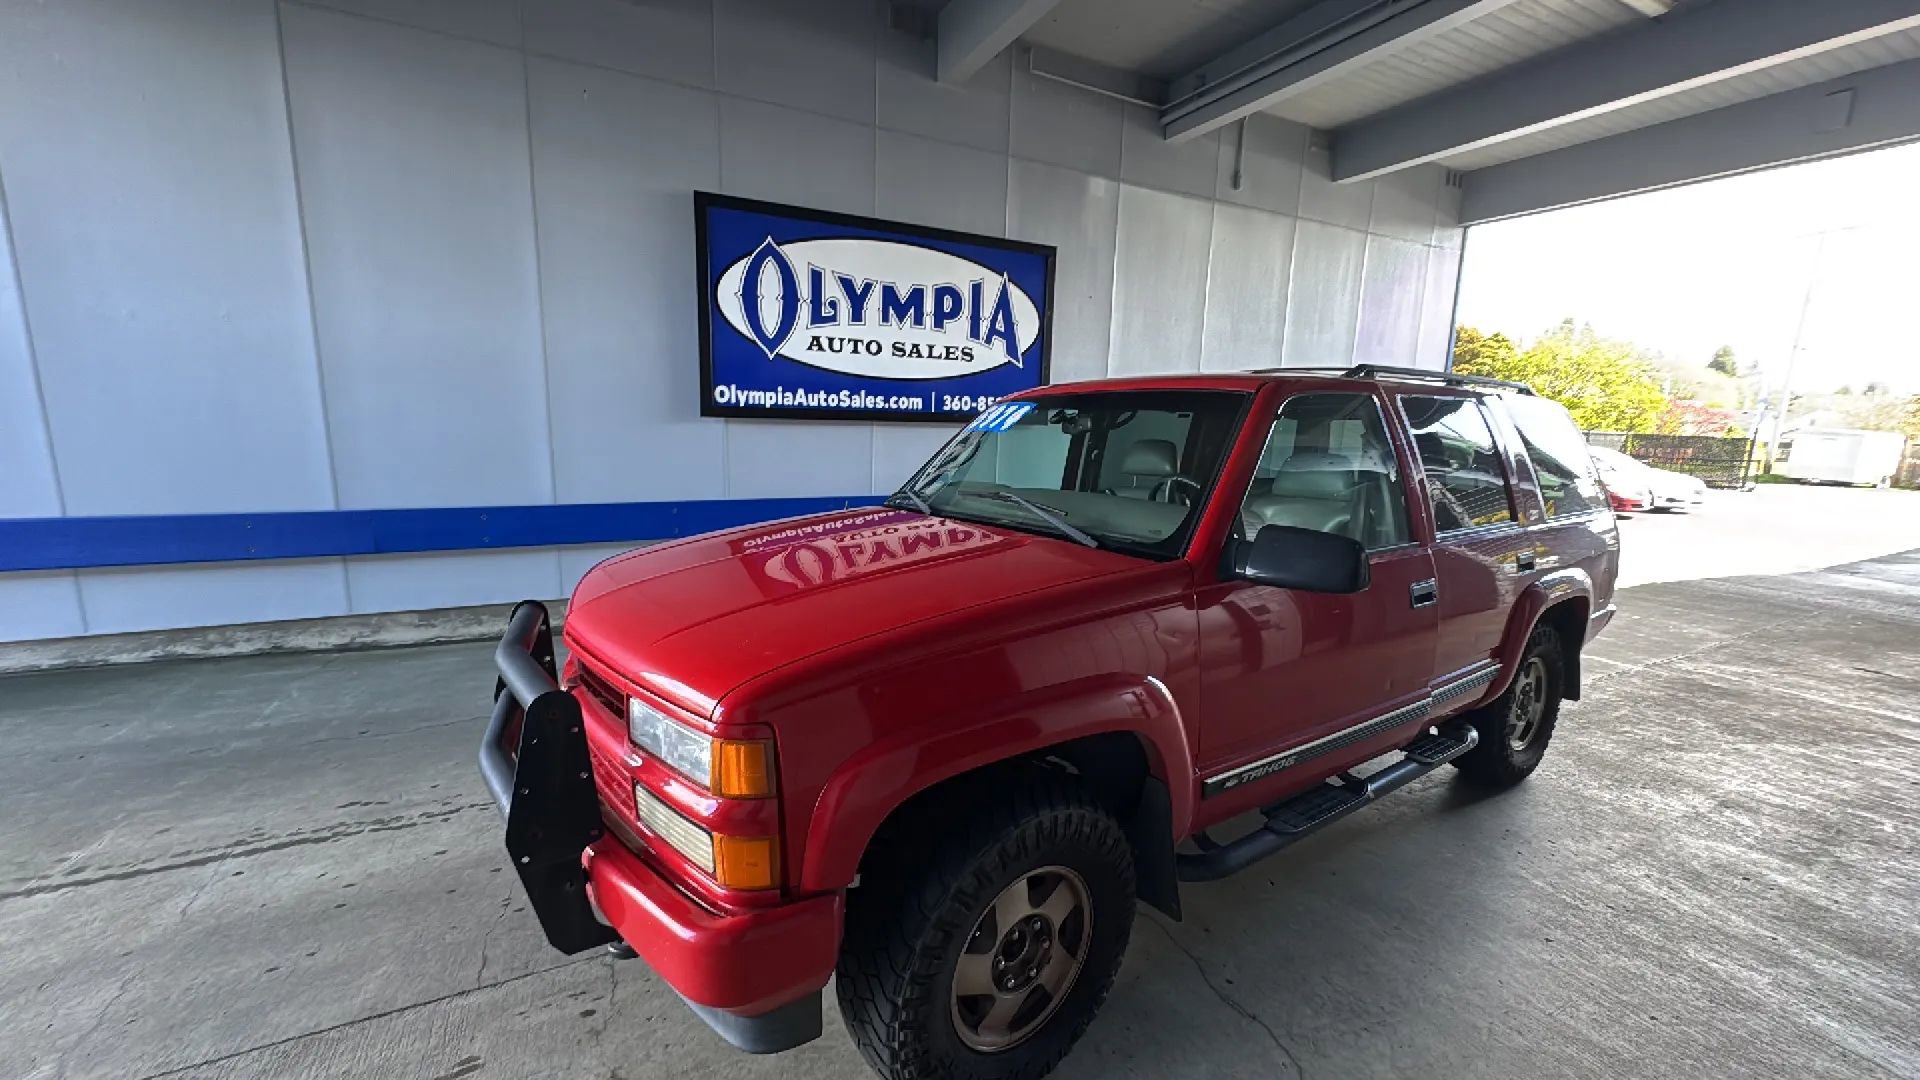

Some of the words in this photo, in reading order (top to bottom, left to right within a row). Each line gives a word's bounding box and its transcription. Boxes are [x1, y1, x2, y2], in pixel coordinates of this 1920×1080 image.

[735, 235, 1024, 368] OLYMPIA
[806, 335, 883, 357] AUTO
[891, 342, 975, 363] SALES
[713, 384, 923, 411] OlympiaAutoSales.com
[943, 395, 1002, 412] 360-85
